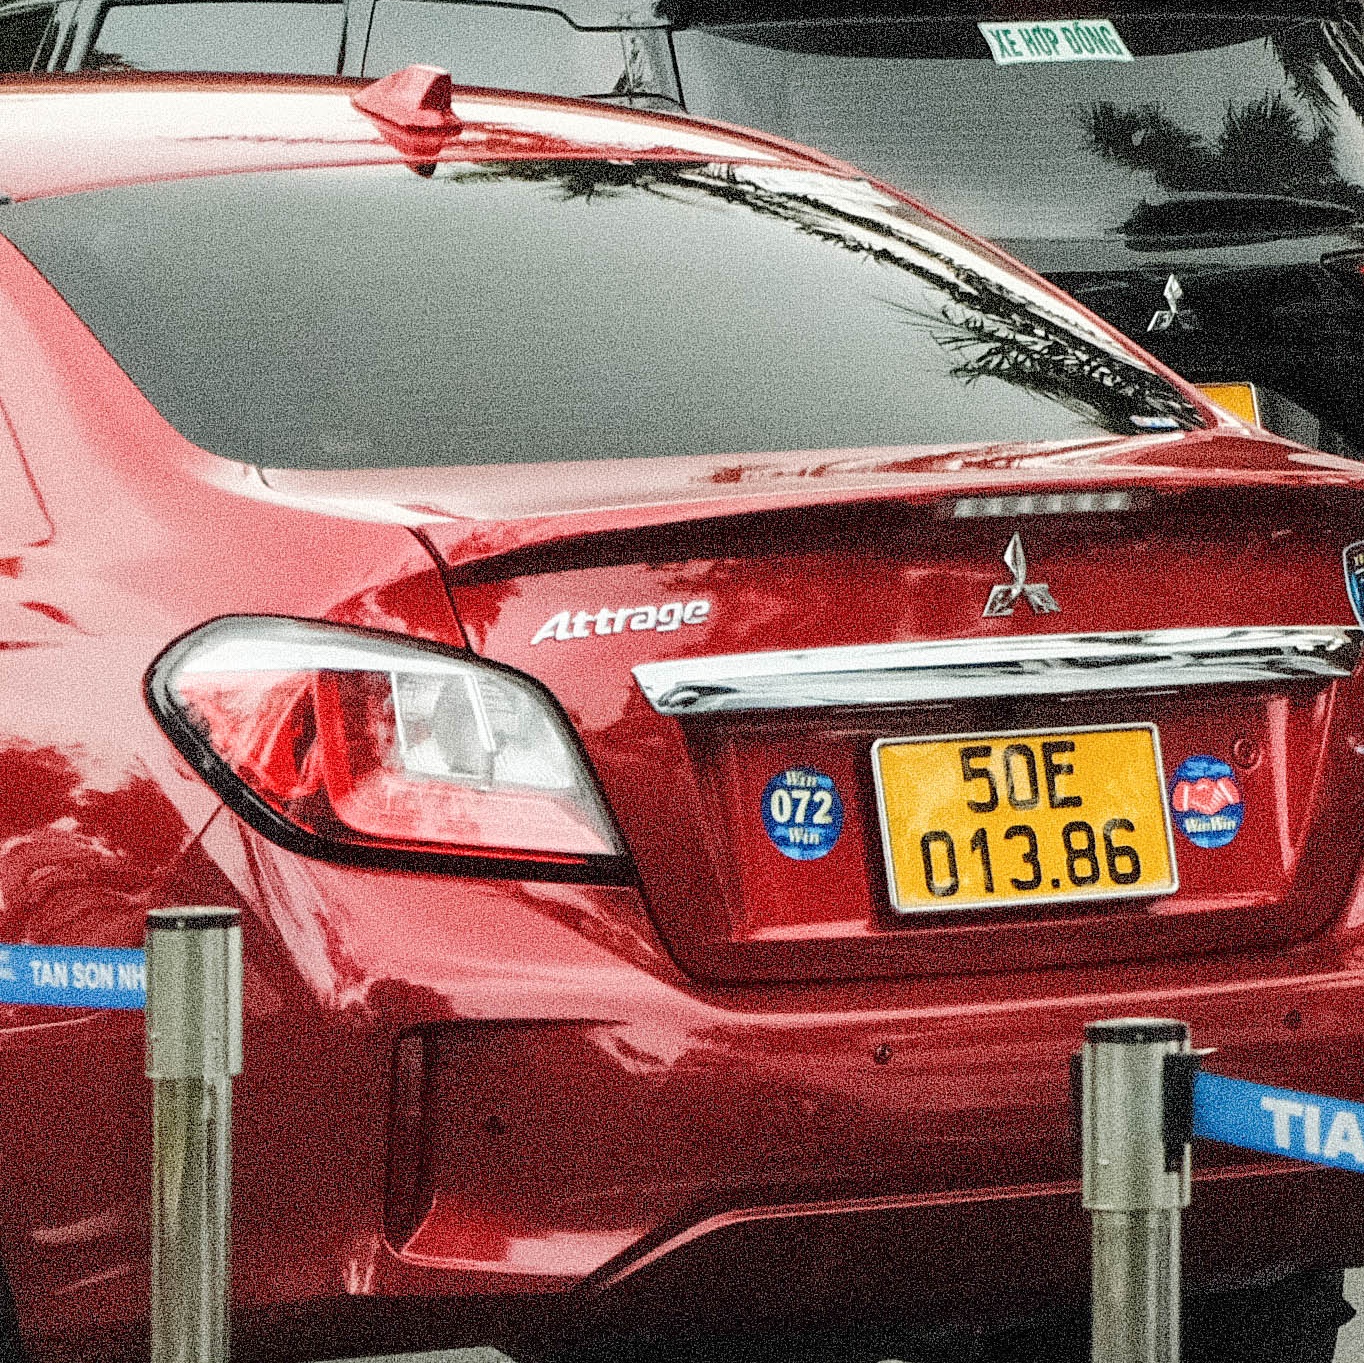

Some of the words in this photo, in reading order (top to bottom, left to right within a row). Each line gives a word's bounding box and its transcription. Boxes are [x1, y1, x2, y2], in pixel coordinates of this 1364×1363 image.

[989, 28, 1023, 59] XE
[530, 599, 711, 645] Attrage
[786, 770, 817, 787] Win
[959, 740, 1082, 813] 50E
[771, 789, 833, 824] 072
[788, 827, 820, 845] Win
[920, 818, 1141, 897] 013.86
[29, 959, 68, 987] TAN
[72, 961, 113, 989] SON
[118, 963, 146, 990] NH
